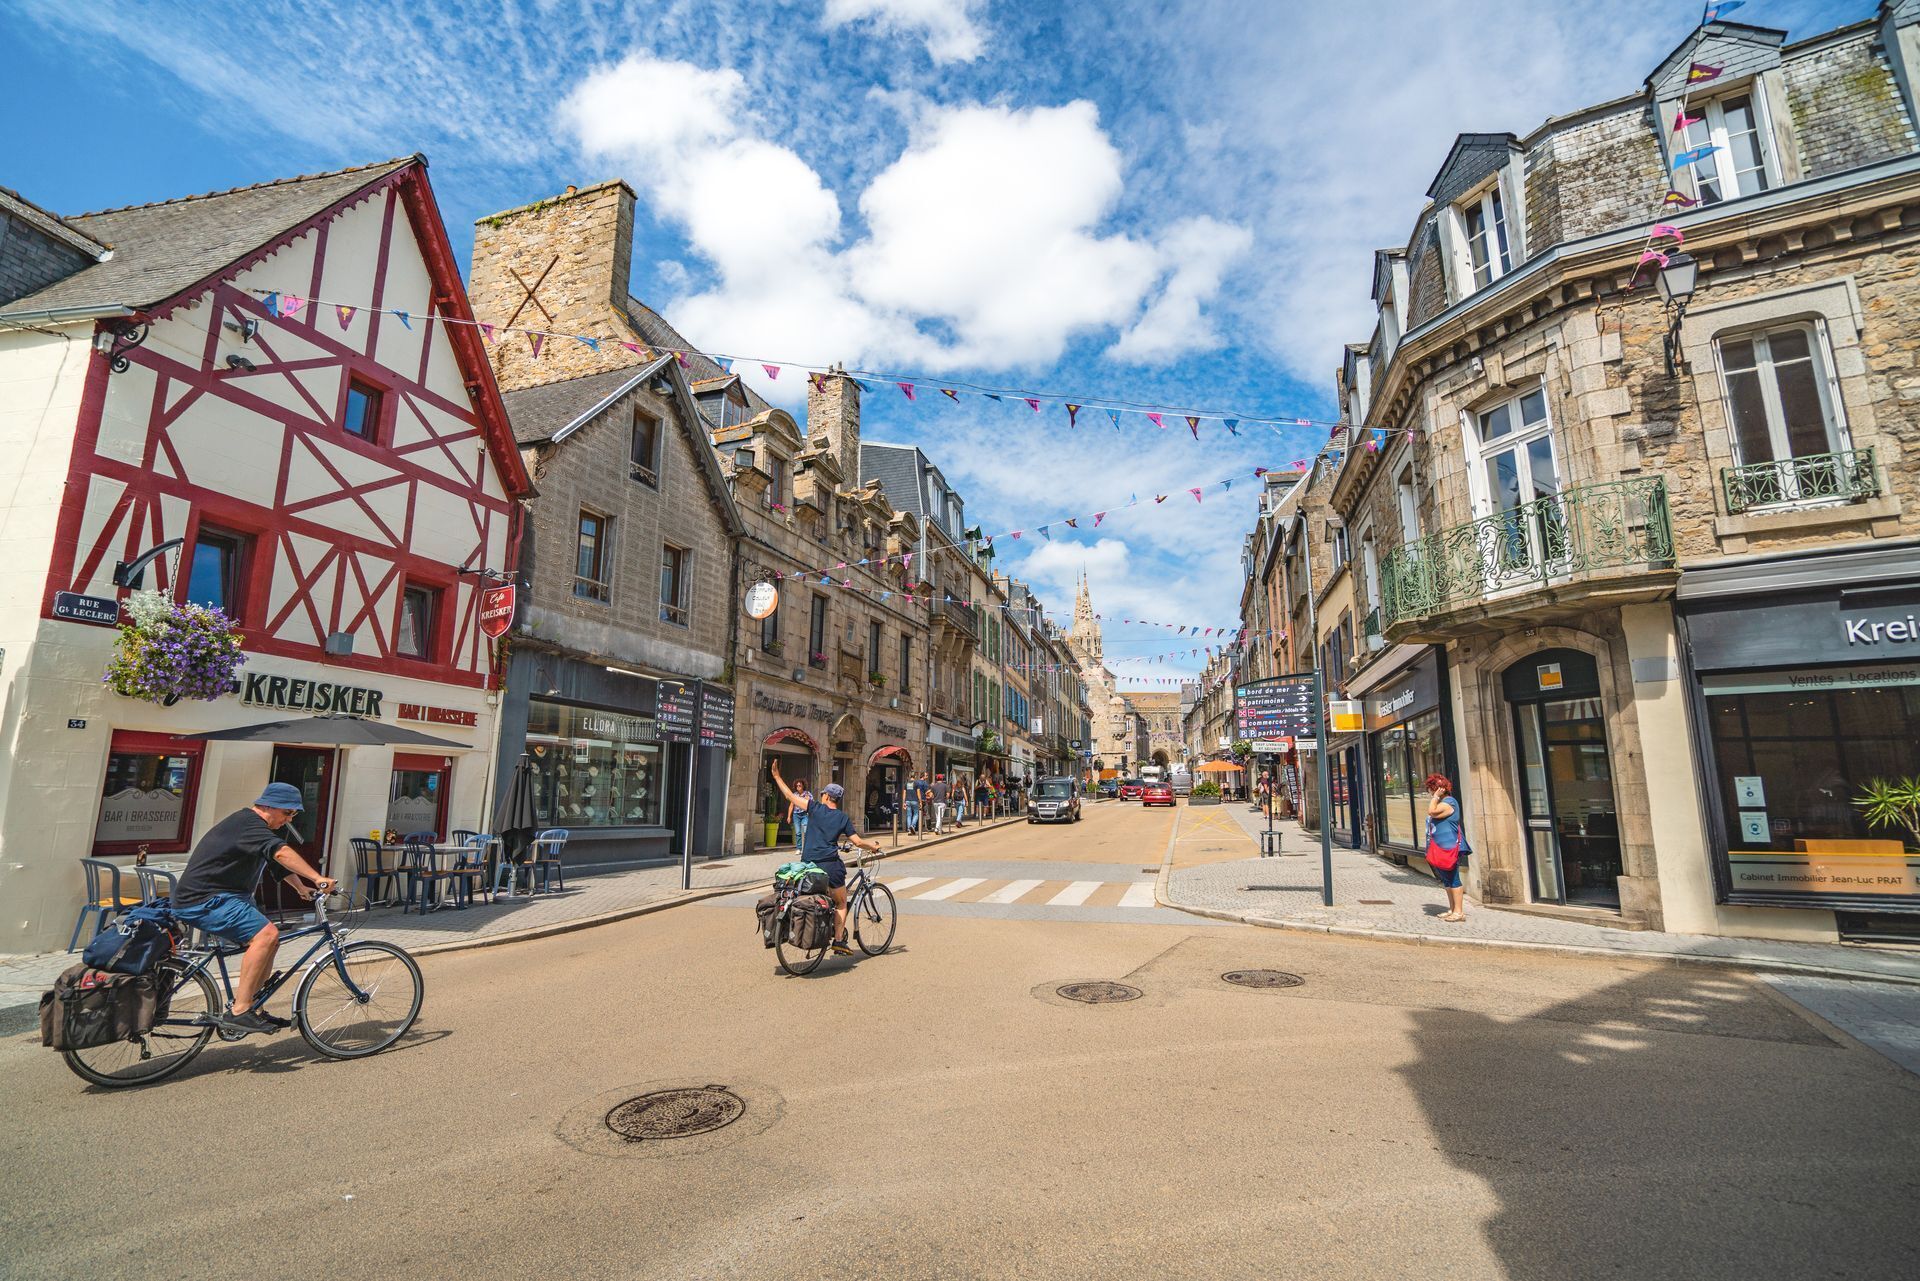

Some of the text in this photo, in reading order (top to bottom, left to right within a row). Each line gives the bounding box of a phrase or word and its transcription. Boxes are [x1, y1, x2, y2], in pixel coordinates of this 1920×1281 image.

[79, 598, 100, 609] RUE
[73, 608, 116, 621] LECLERC
[481, 605, 512, 620] KREISKER
[1788, 674, 1834, 685] Ventes
[1849, 670, 1917, 682] Locations
[243, 672, 384, 719] KREISKER
[1247, 698, 1285, 707] patrimoine
[398, 703, 478, 727] BAR BRASSERIE
[583, 717, 615, 733] ELLORA
[1258, 730, 1285, 738] parking
[104, 810, 178, 822] BAR BRASSERIE
[1740, 873, 1903, 885] Cabinet Immobilier Jean-Luc PRAT
